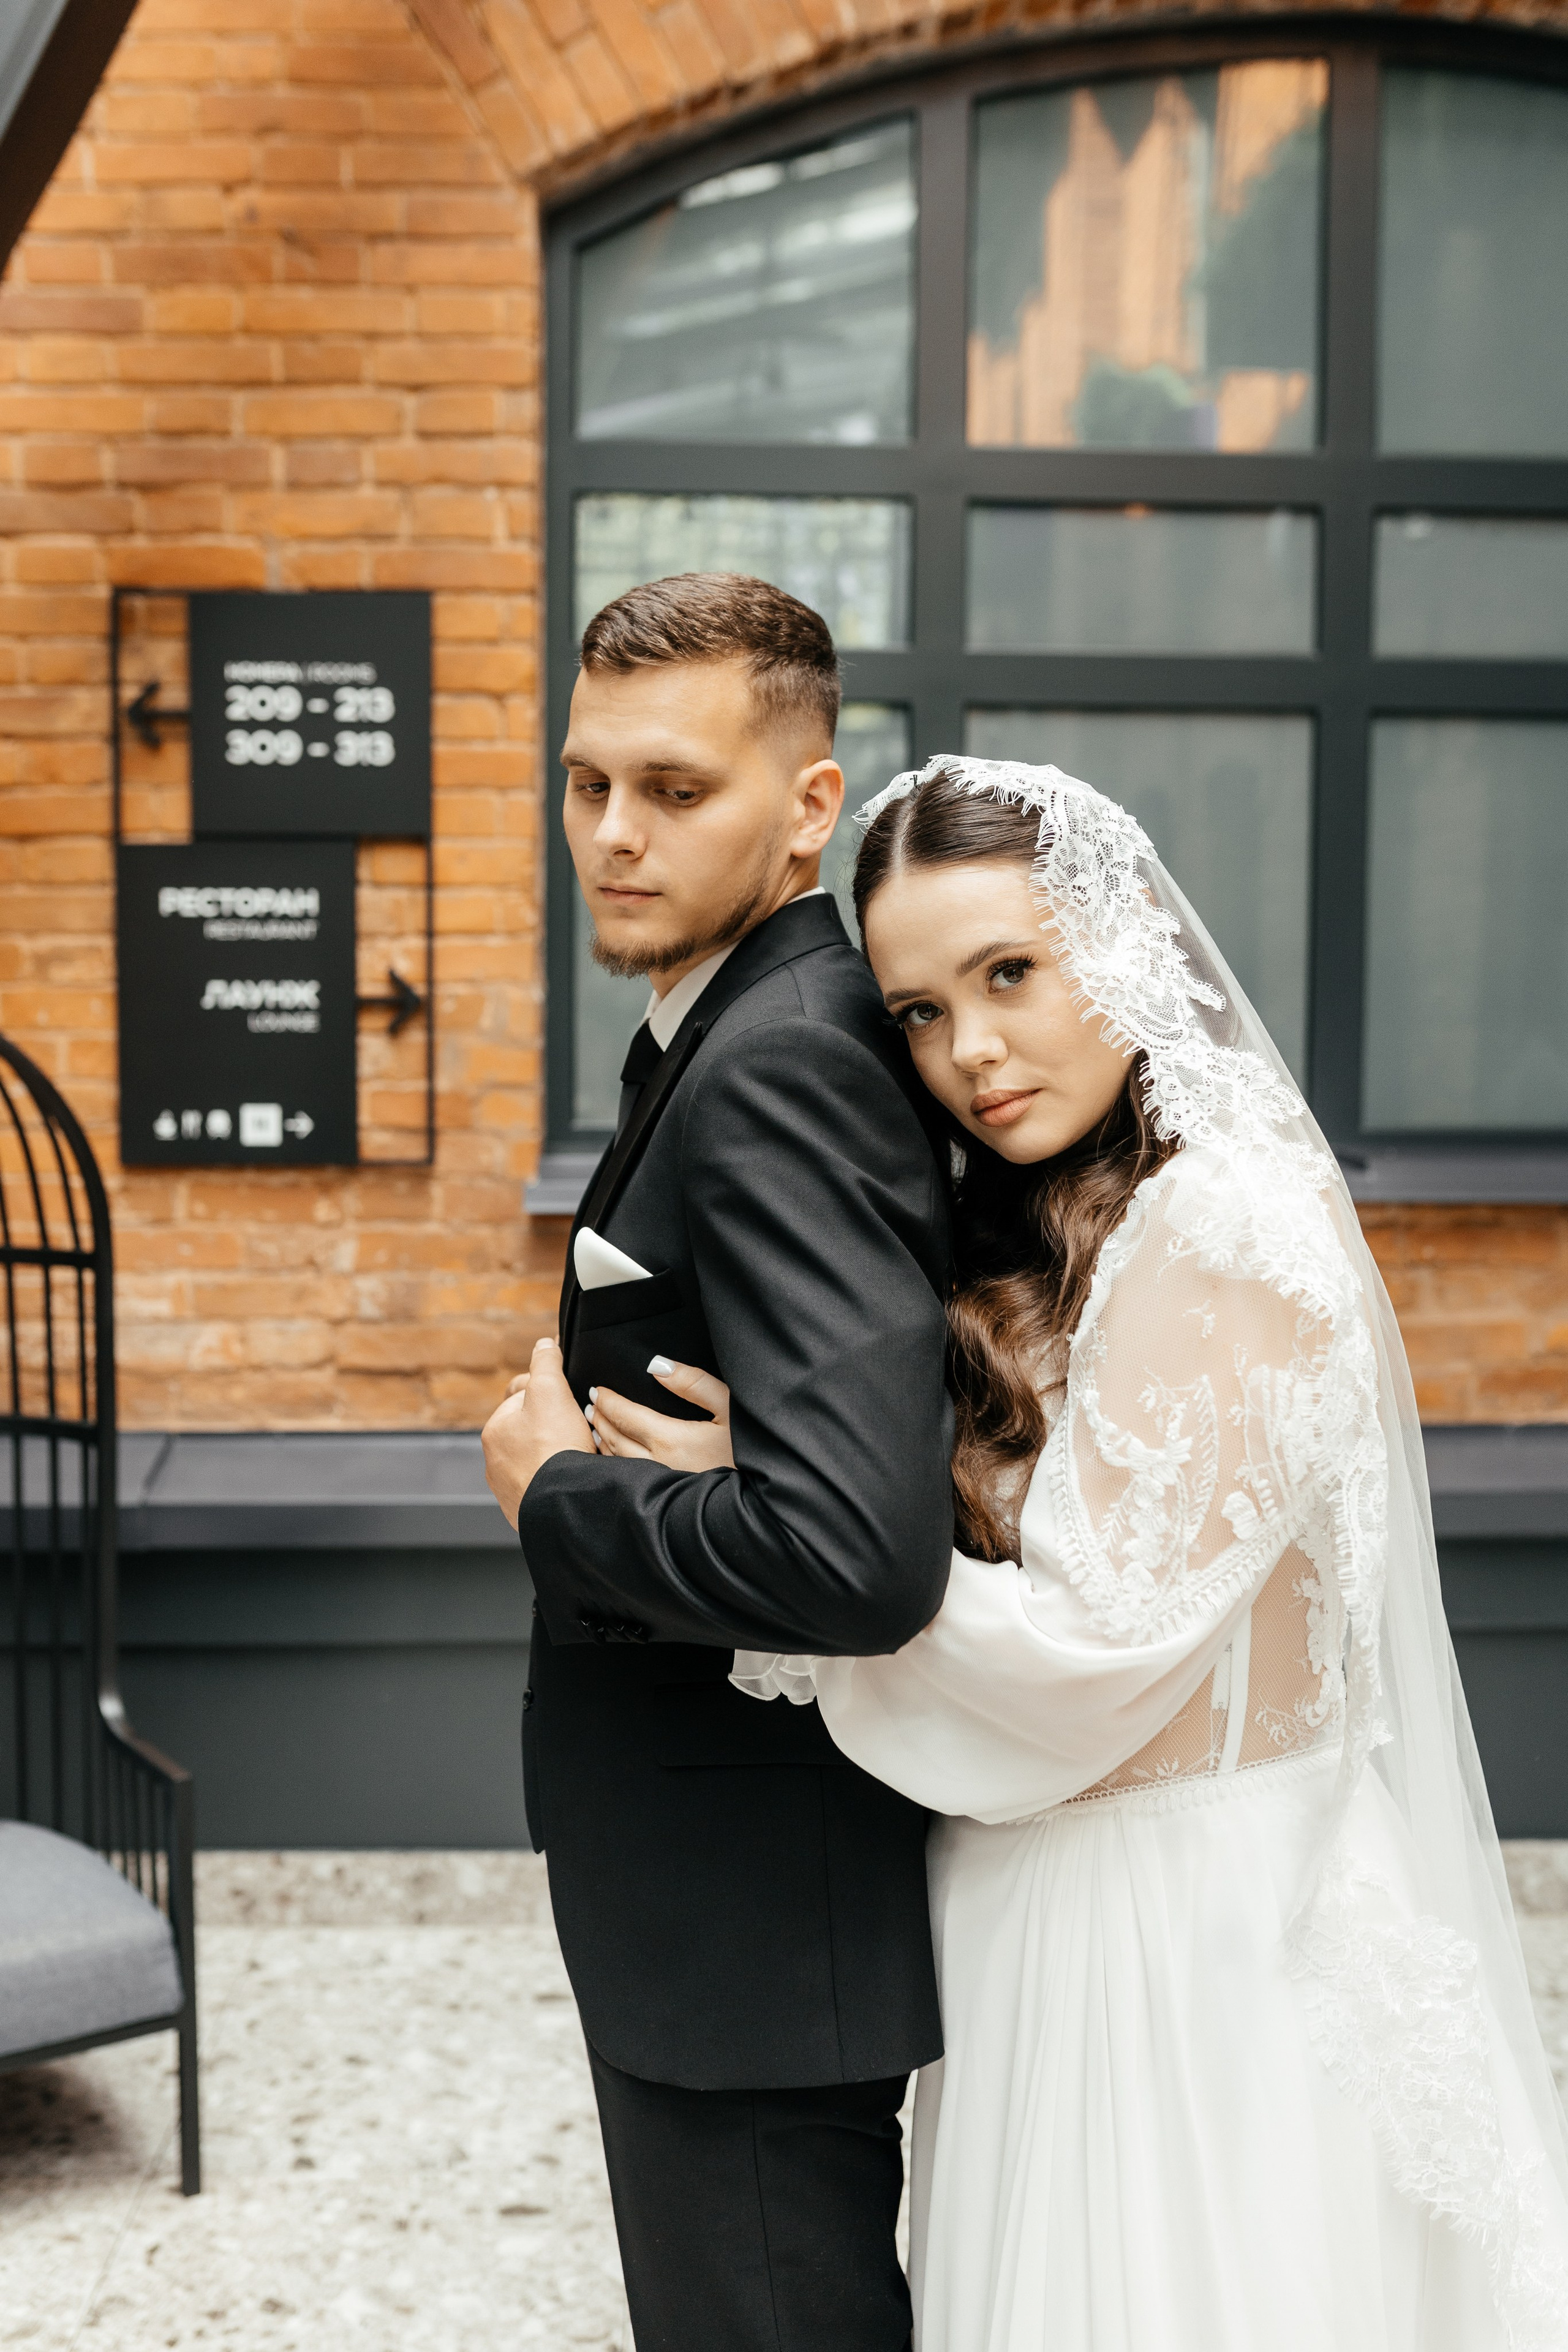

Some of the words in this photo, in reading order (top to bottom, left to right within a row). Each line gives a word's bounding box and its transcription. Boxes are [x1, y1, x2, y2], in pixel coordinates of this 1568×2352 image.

[224, 685, 303, 722] 209
[333, 686, 396, 723] 213
[224, 729, 304, 766] 309
[333, 730, 396, 767] 313
[158, 887, 320, 918] РЕСТОРАН
[203, 919, 318, 941] RESTAURANT
[200, 979, 320, 1010] ЛАУНЖ
[247, 1011, 320, 1033] LOUNGE
